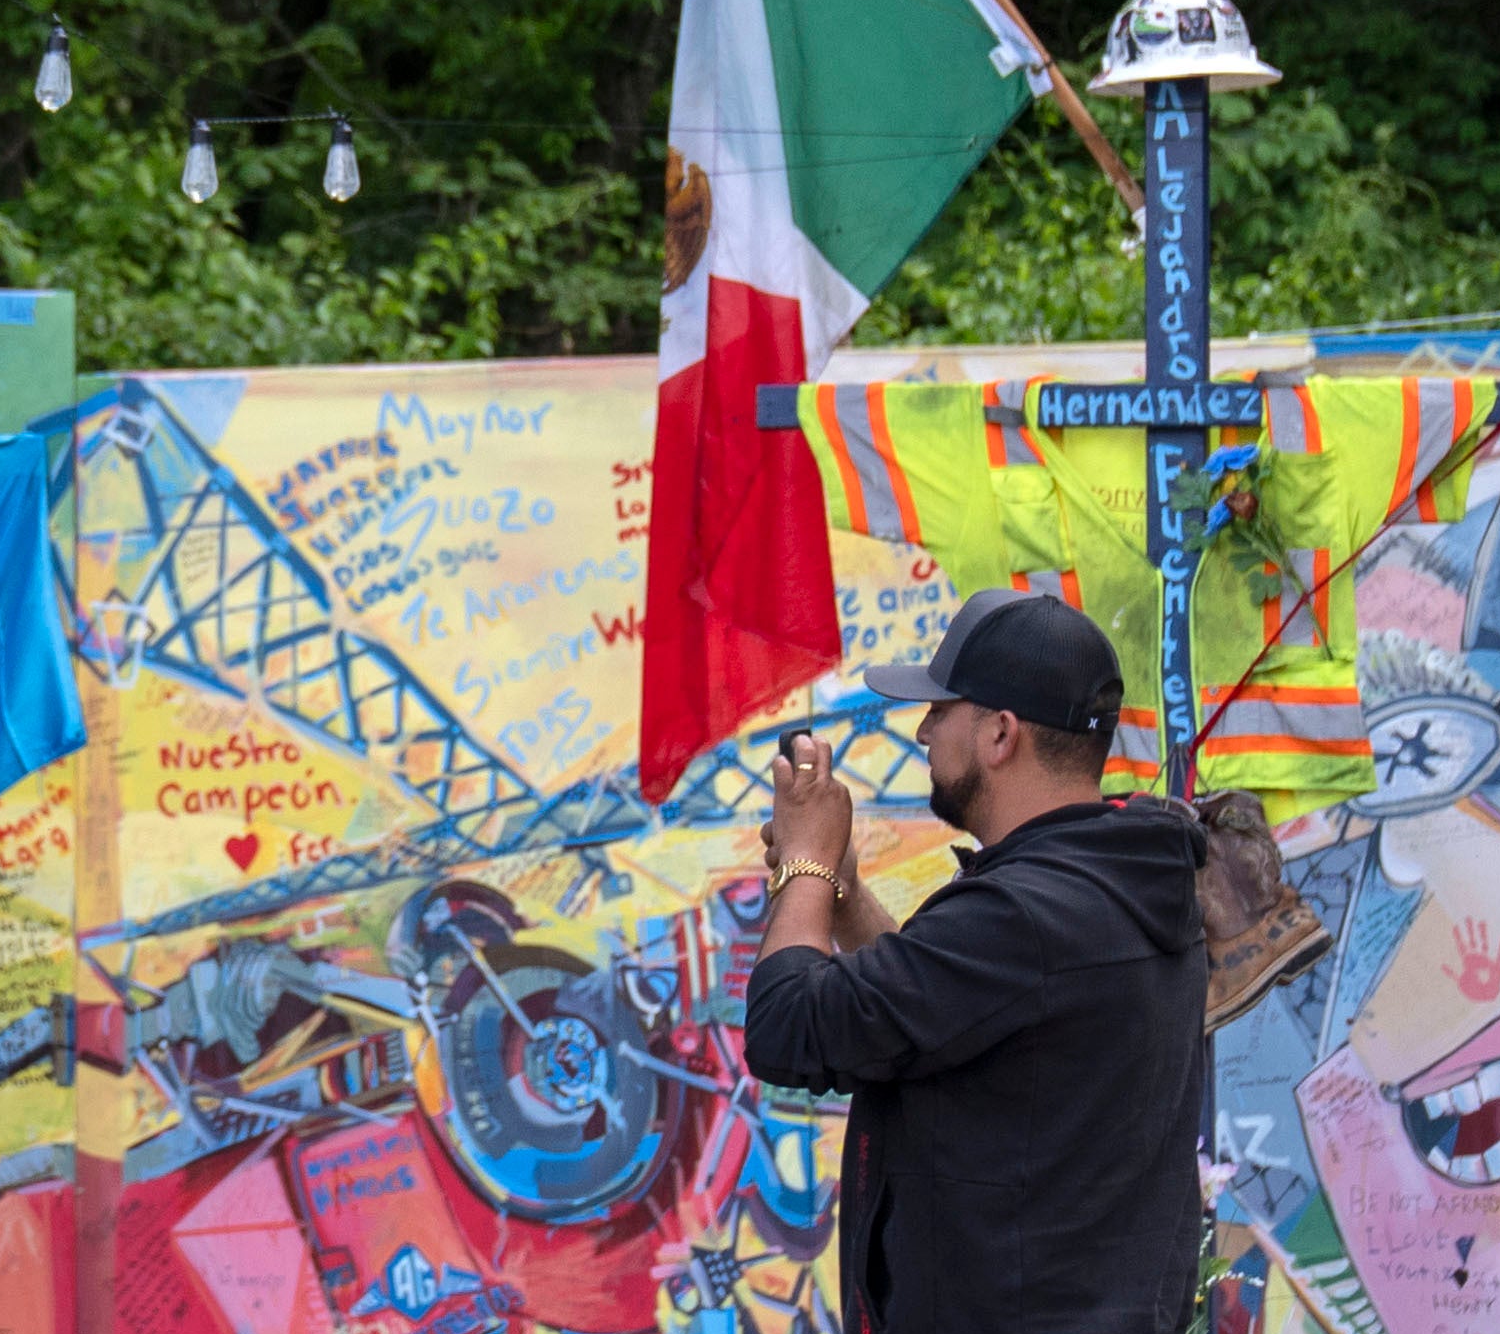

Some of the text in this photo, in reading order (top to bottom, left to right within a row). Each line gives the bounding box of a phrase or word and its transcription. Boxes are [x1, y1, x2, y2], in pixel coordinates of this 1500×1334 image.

[377, 391, 554, 454] Maynor
[1040, 387, 1262, 425] Hernandez
[158, 731, 303, 771] Nuestro
